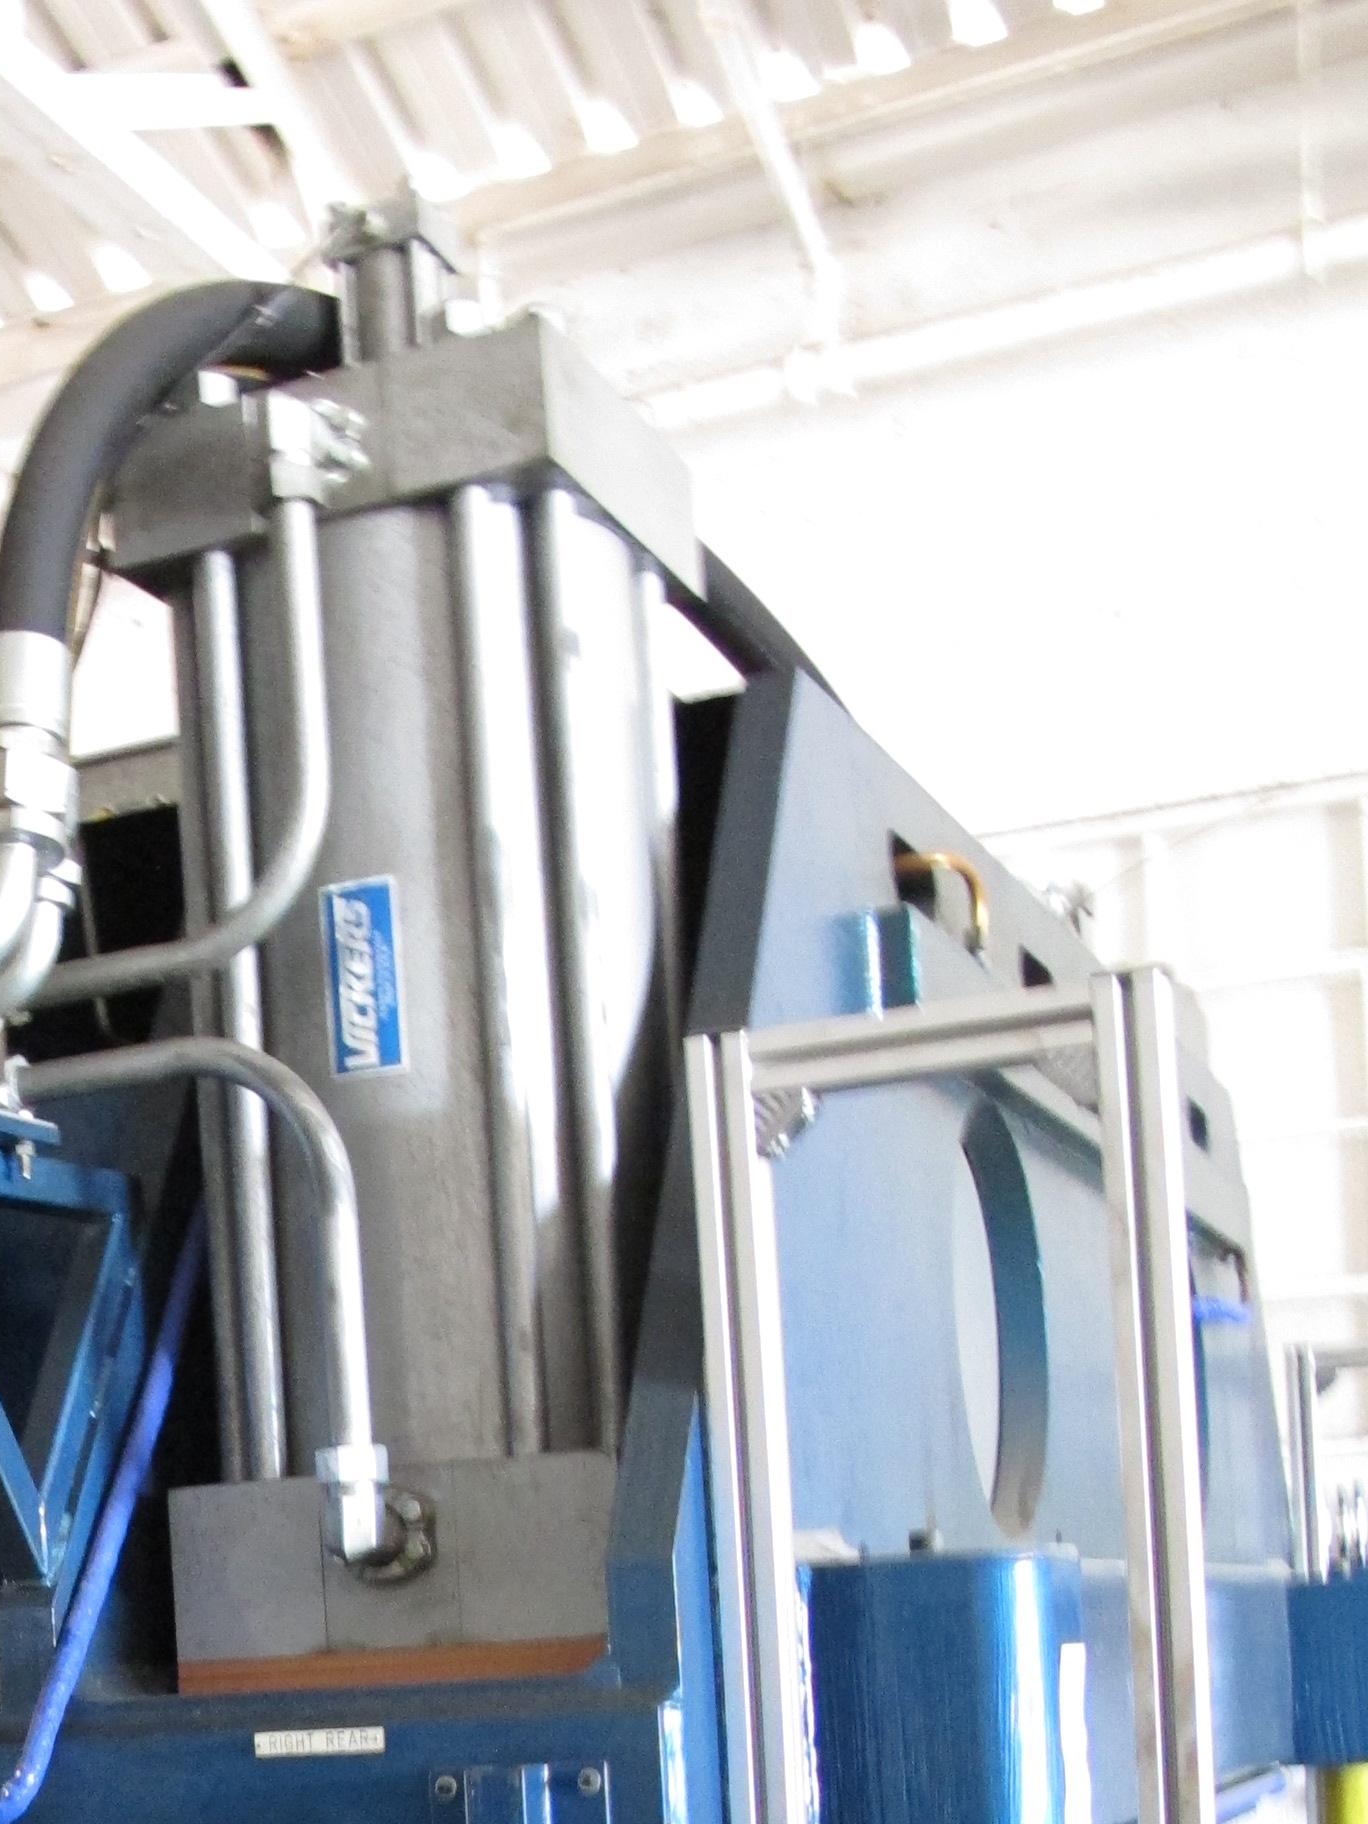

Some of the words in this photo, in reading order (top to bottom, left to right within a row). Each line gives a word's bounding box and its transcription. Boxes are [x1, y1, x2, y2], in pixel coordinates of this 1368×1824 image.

[332, 893, 382, 1071] VICKERS
[267, 1731, 313, 1754] RIGHT
[325, 1729, 369, 1750] REAR
